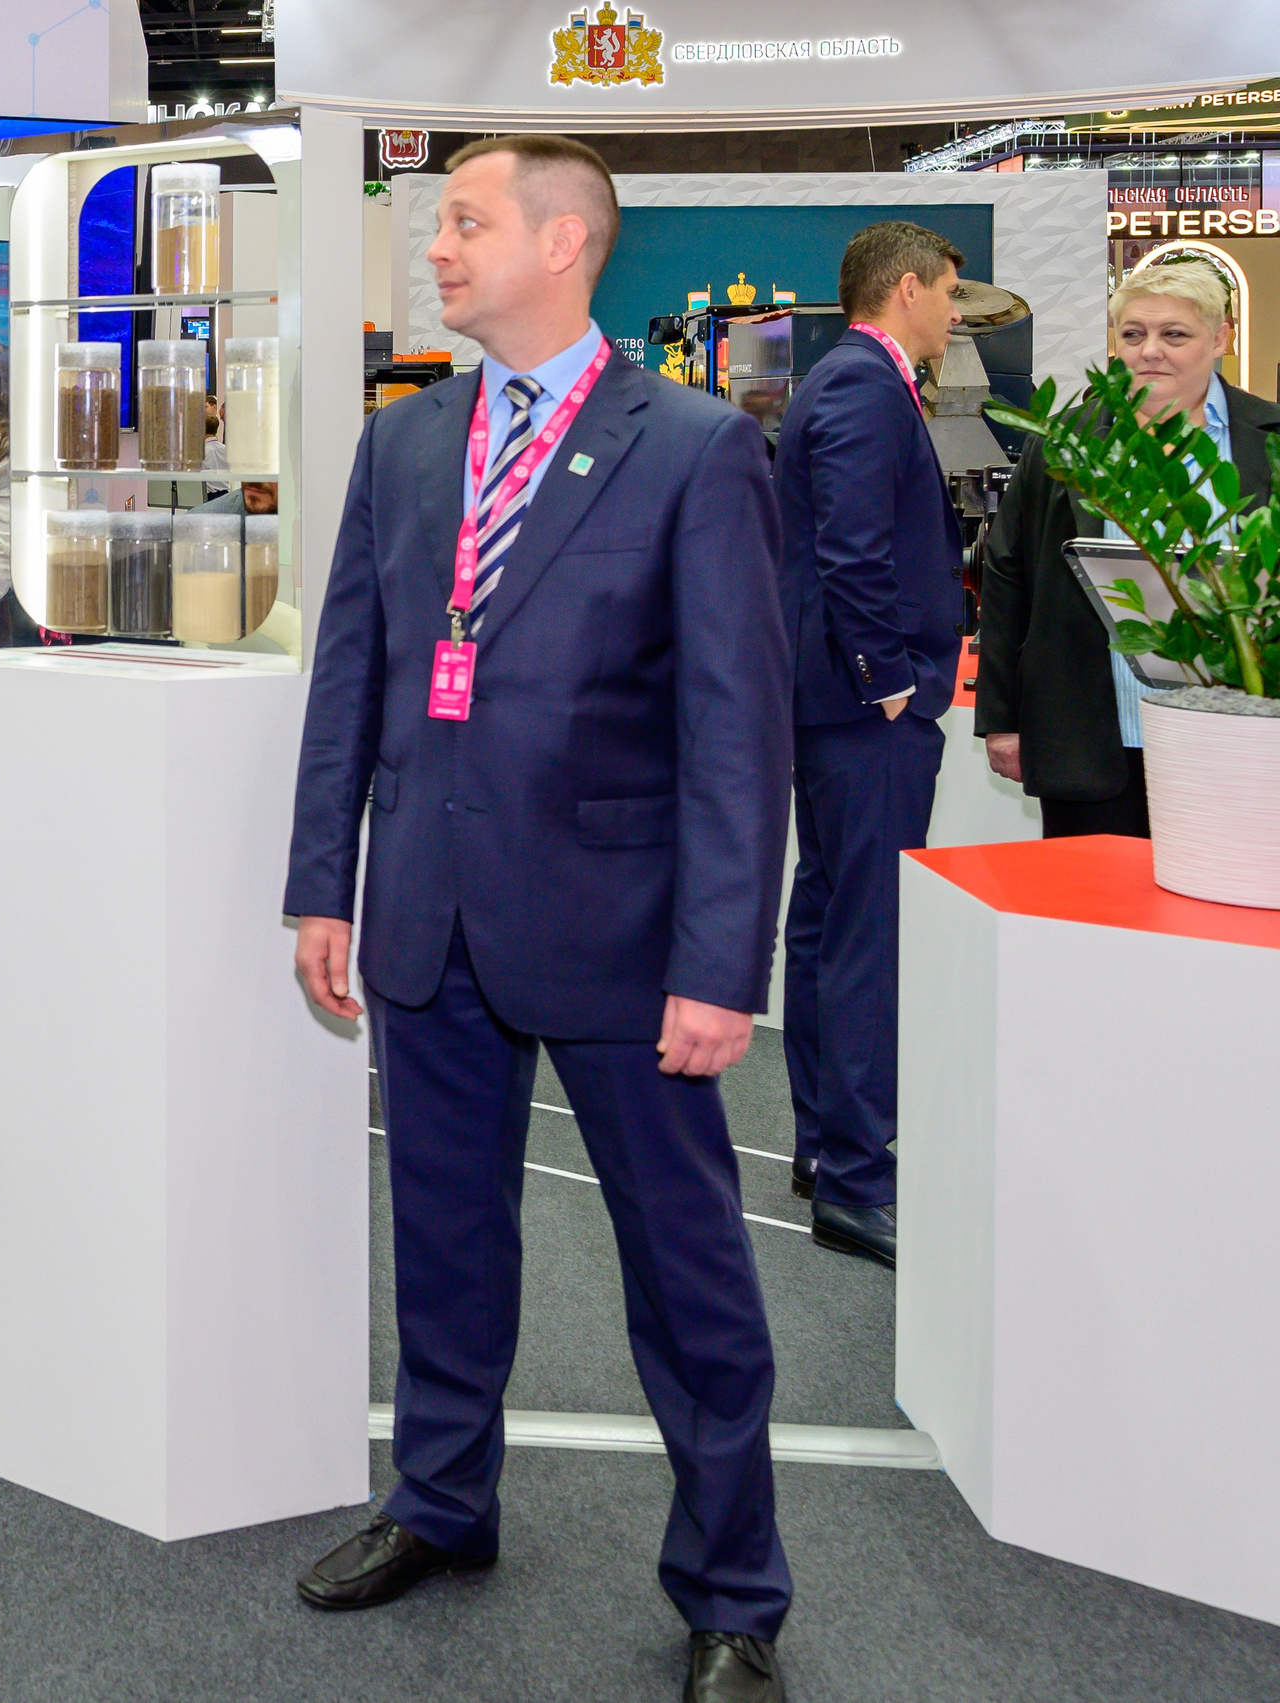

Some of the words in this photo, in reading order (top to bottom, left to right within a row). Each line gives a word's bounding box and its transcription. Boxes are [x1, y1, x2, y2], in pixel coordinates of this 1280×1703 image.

[674, 41, 811, 62] СВЕРДЛОВСКАЯ
[820, 37, 900, 57] ОБЛАСТЬ
[1174, 186, 1250, 203] ОБЛАСТЬ
